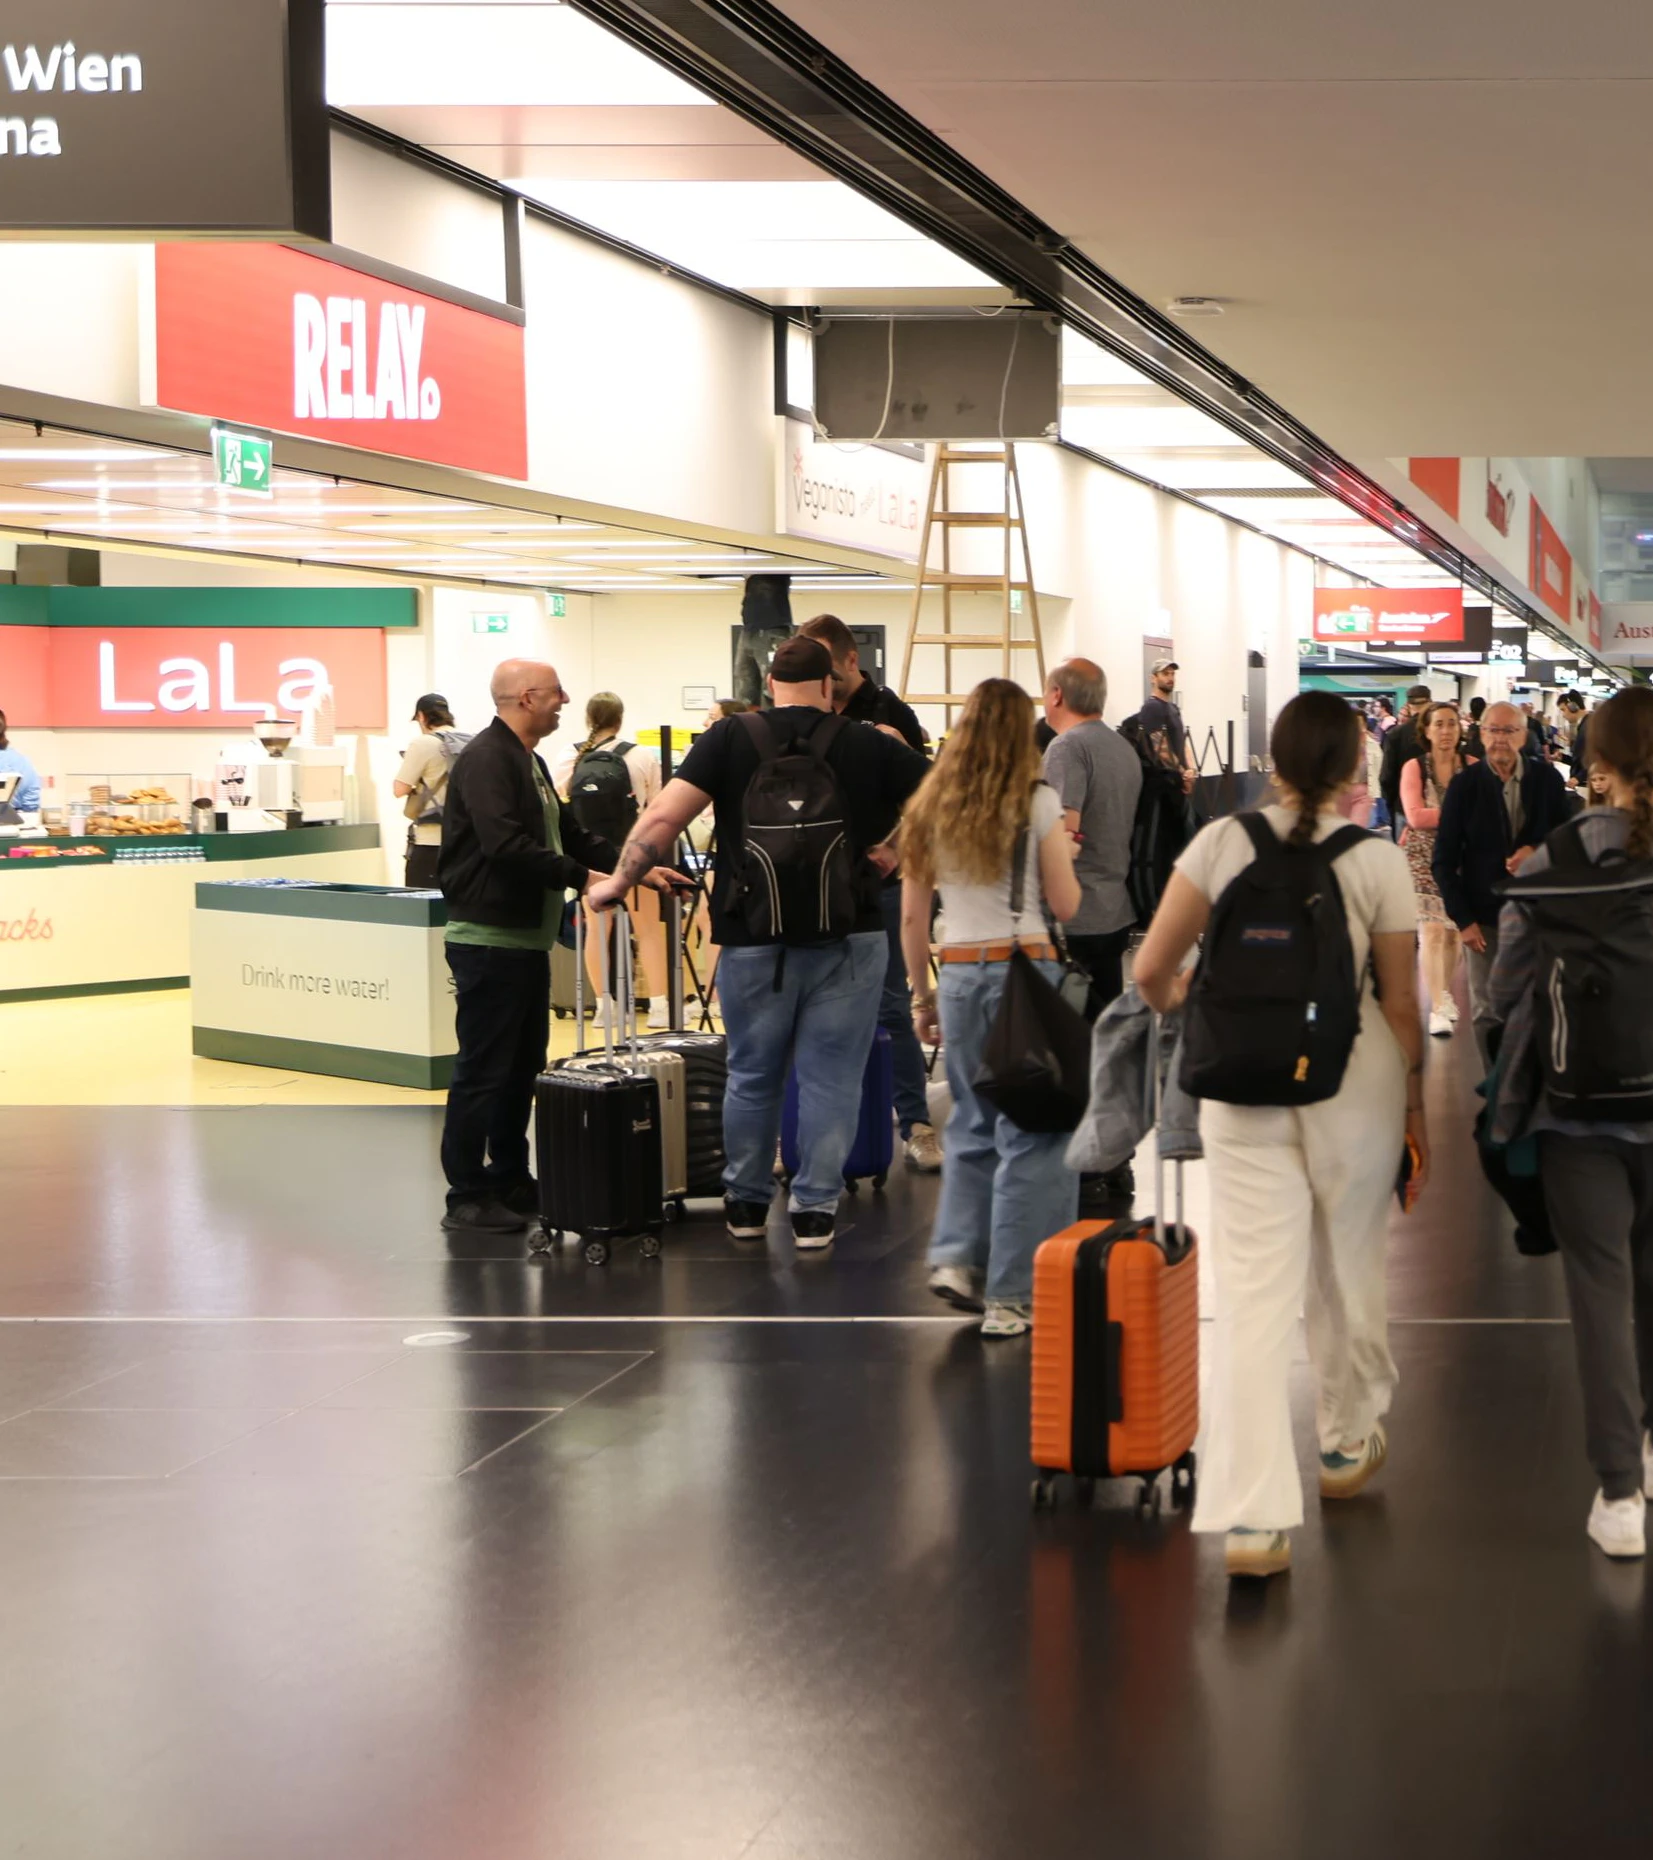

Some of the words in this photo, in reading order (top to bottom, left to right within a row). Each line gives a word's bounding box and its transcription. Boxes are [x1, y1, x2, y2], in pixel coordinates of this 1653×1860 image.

[3, 40, 142, 93] Wien
[293, 292, 426, 421] RELAY
[99, 641, 330, 713] LaLa
[241, 963, 286, 990] Drink
[288, 973, 332, 994] more
